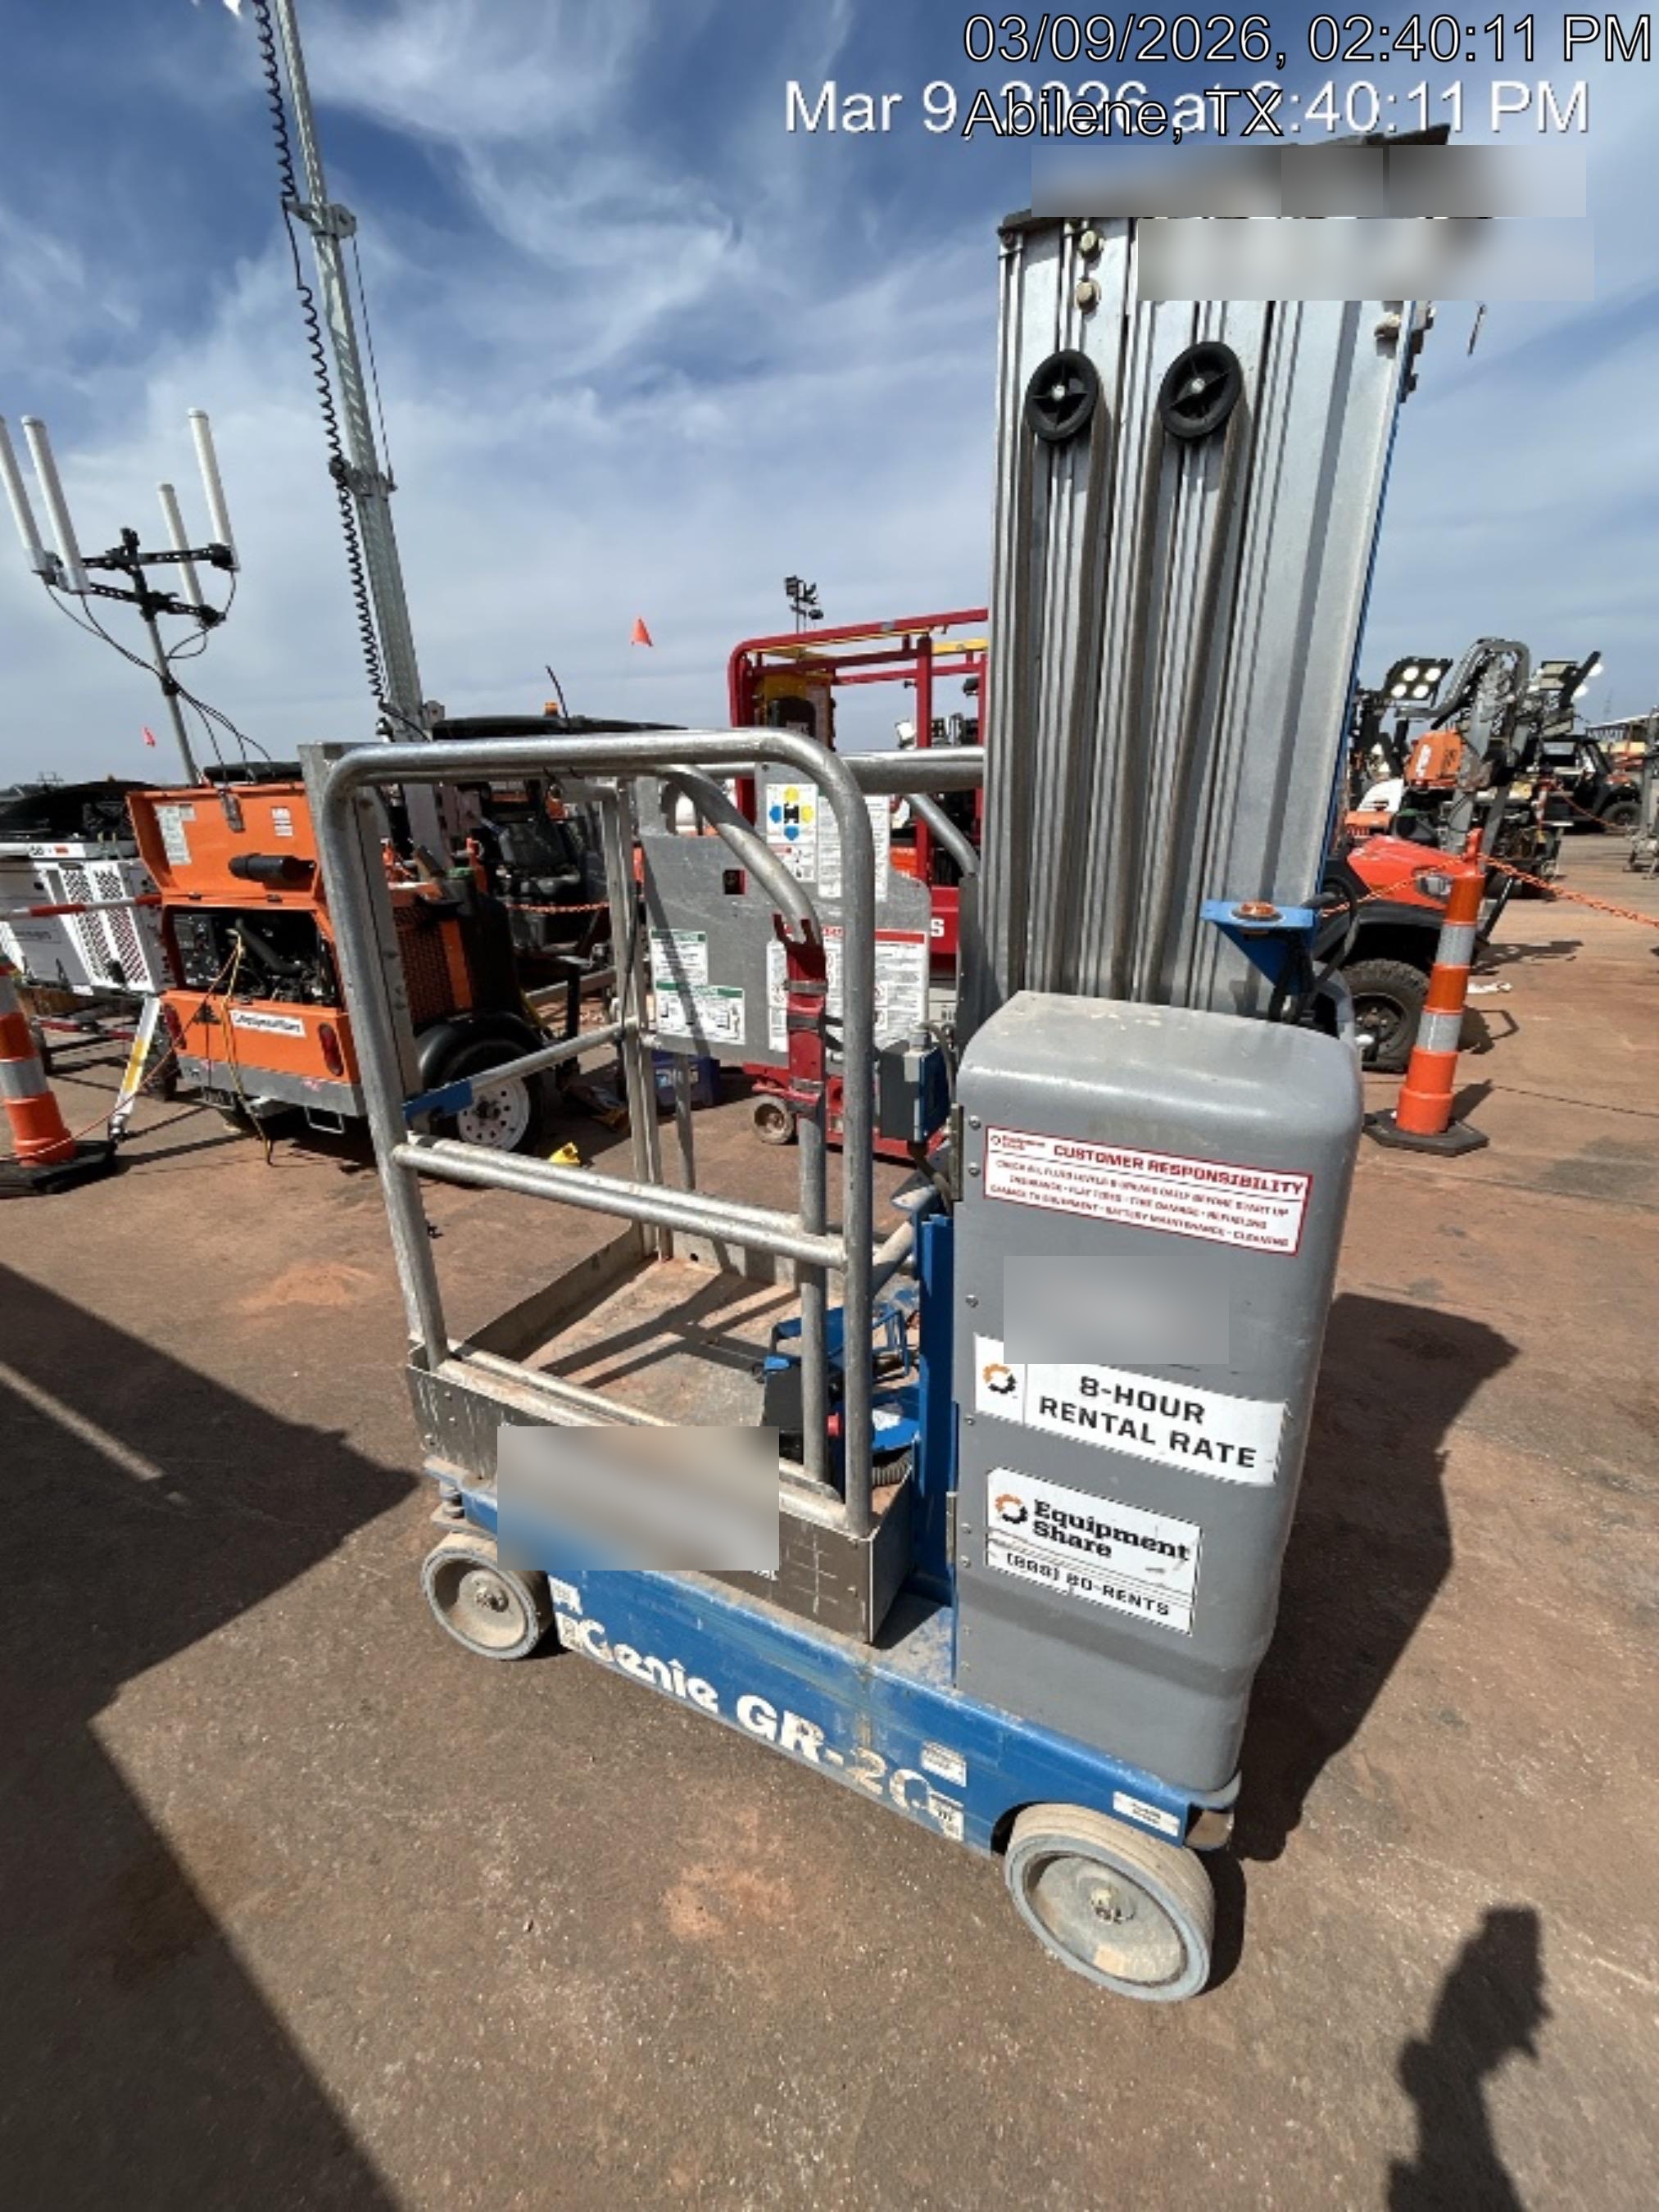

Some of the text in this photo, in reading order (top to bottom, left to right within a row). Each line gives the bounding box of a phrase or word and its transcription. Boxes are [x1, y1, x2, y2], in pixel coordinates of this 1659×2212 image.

[1054, 1145, 1304, 1195] CUSTOMER RESPONSIBILITY
[1079, 1376, 1206, 1425] 8-HOUR
[1039, 1395, 1258, 1468] RENTAL RATE
[1032, 1520, 1113, 1558] Share
[1033, 1498, 1190, 1561] Equipment
[1066, 1573, 1170, 1616] 80-RENTS
